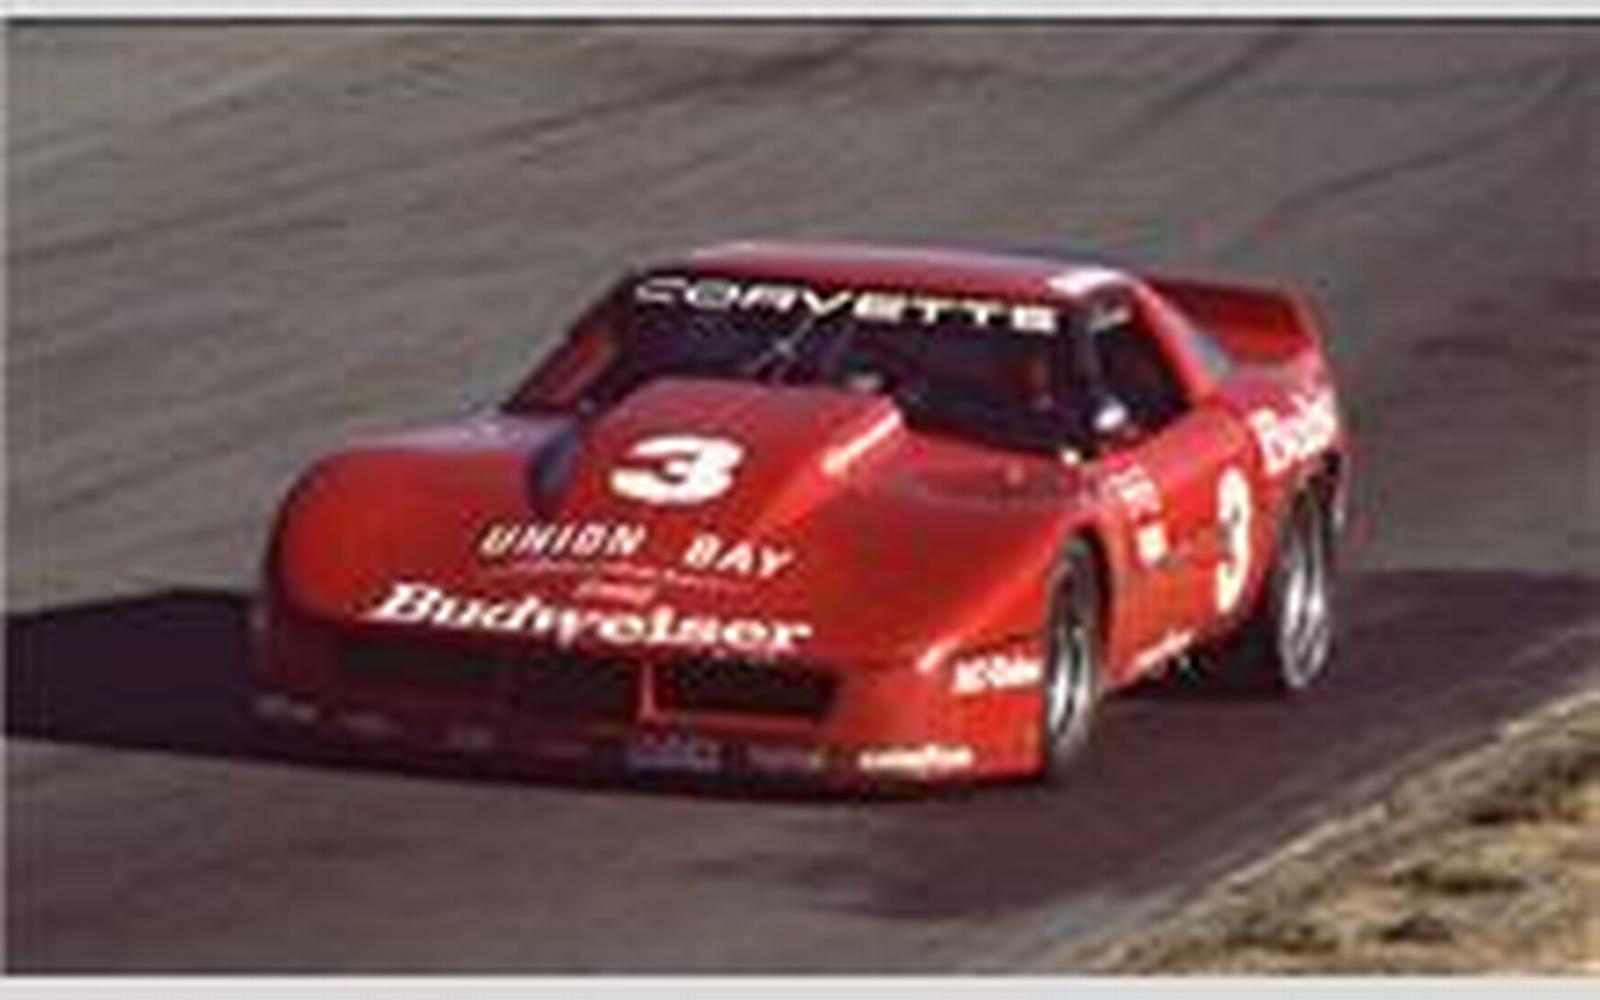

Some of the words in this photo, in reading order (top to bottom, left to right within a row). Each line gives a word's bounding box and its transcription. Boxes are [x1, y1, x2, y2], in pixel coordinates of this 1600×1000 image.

[635, 276, 1056, 333] CORVETTE
[610, 435, 745, 506] 3
[480, 523, 646, 557] UNION
[684, 534, 793, 577] BAY
[1216, 467, 1249, 613] 3
[366, 582, 812, 650] Budweiser
